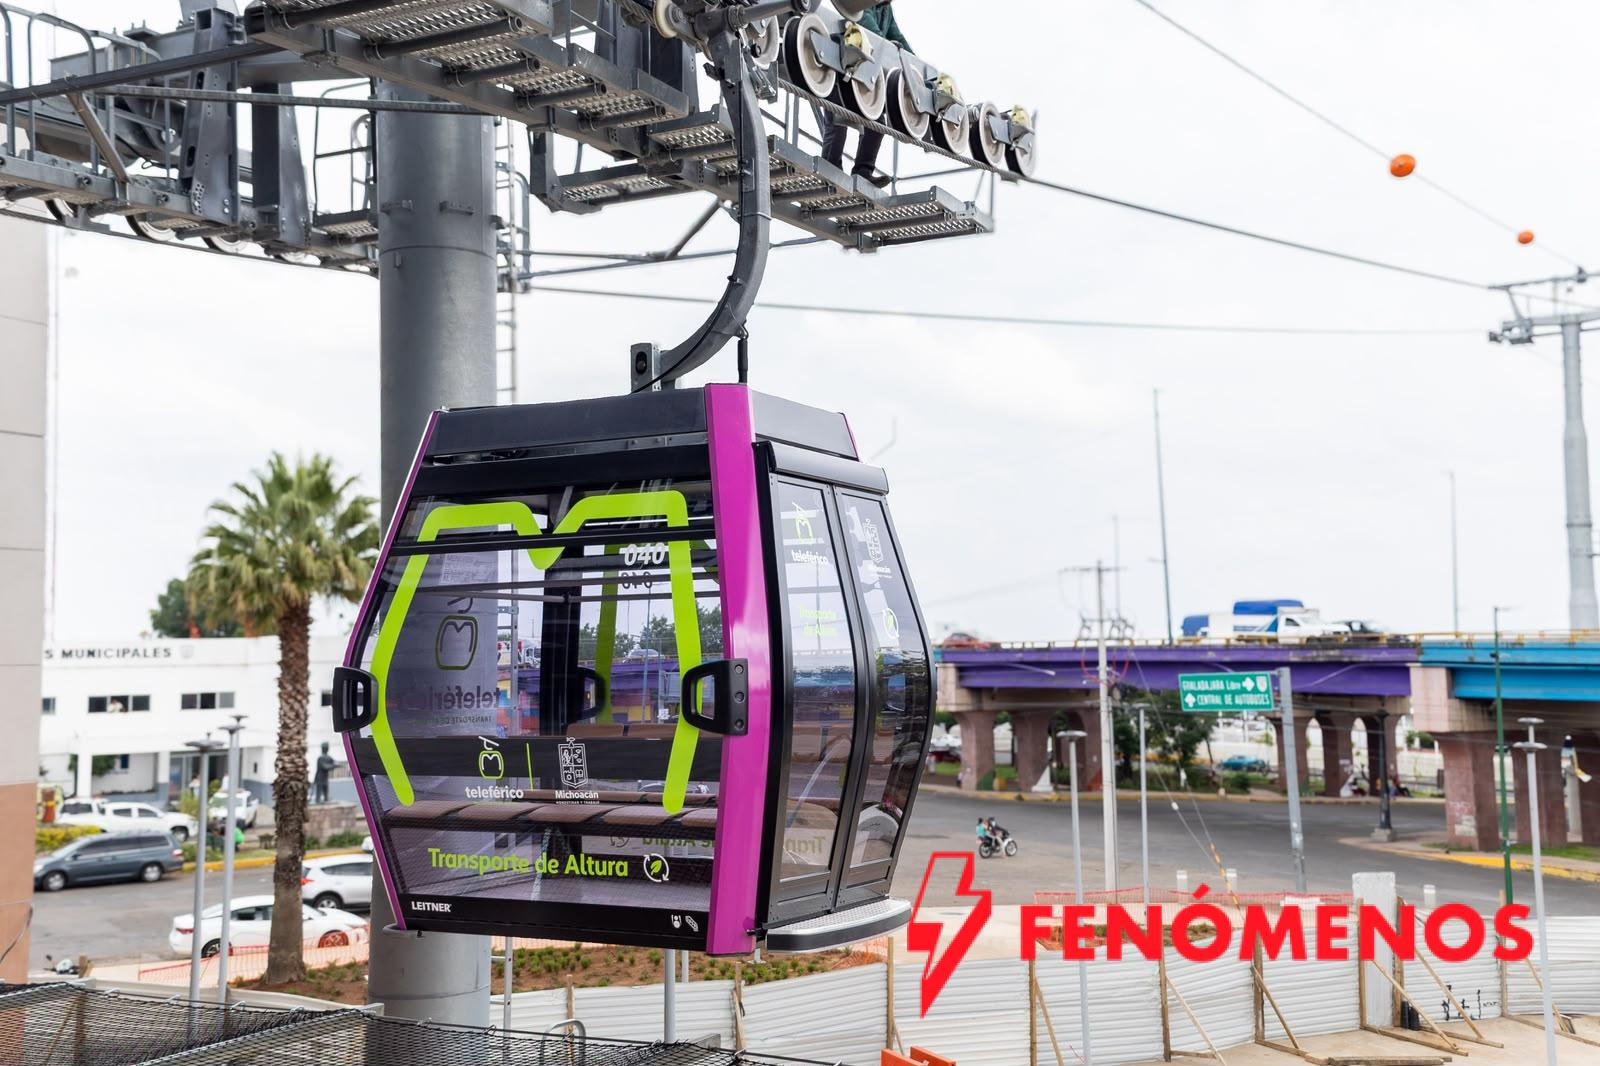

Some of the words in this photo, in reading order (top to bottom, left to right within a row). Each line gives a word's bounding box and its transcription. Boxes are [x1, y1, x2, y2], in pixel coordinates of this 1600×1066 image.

[624, 542, 666, 566] 040
[61, 647, 171, 659] MUNICIPALES
[465, 786, 524, 799] teleférico
[555, 790, 599, 799] Michoacán
[428, 848, 529, 876] Transporte
[535, 852, 559, 875] de
[564, 853, 629, 877] Altura
[411, 901, 452, 912] LEITNER
